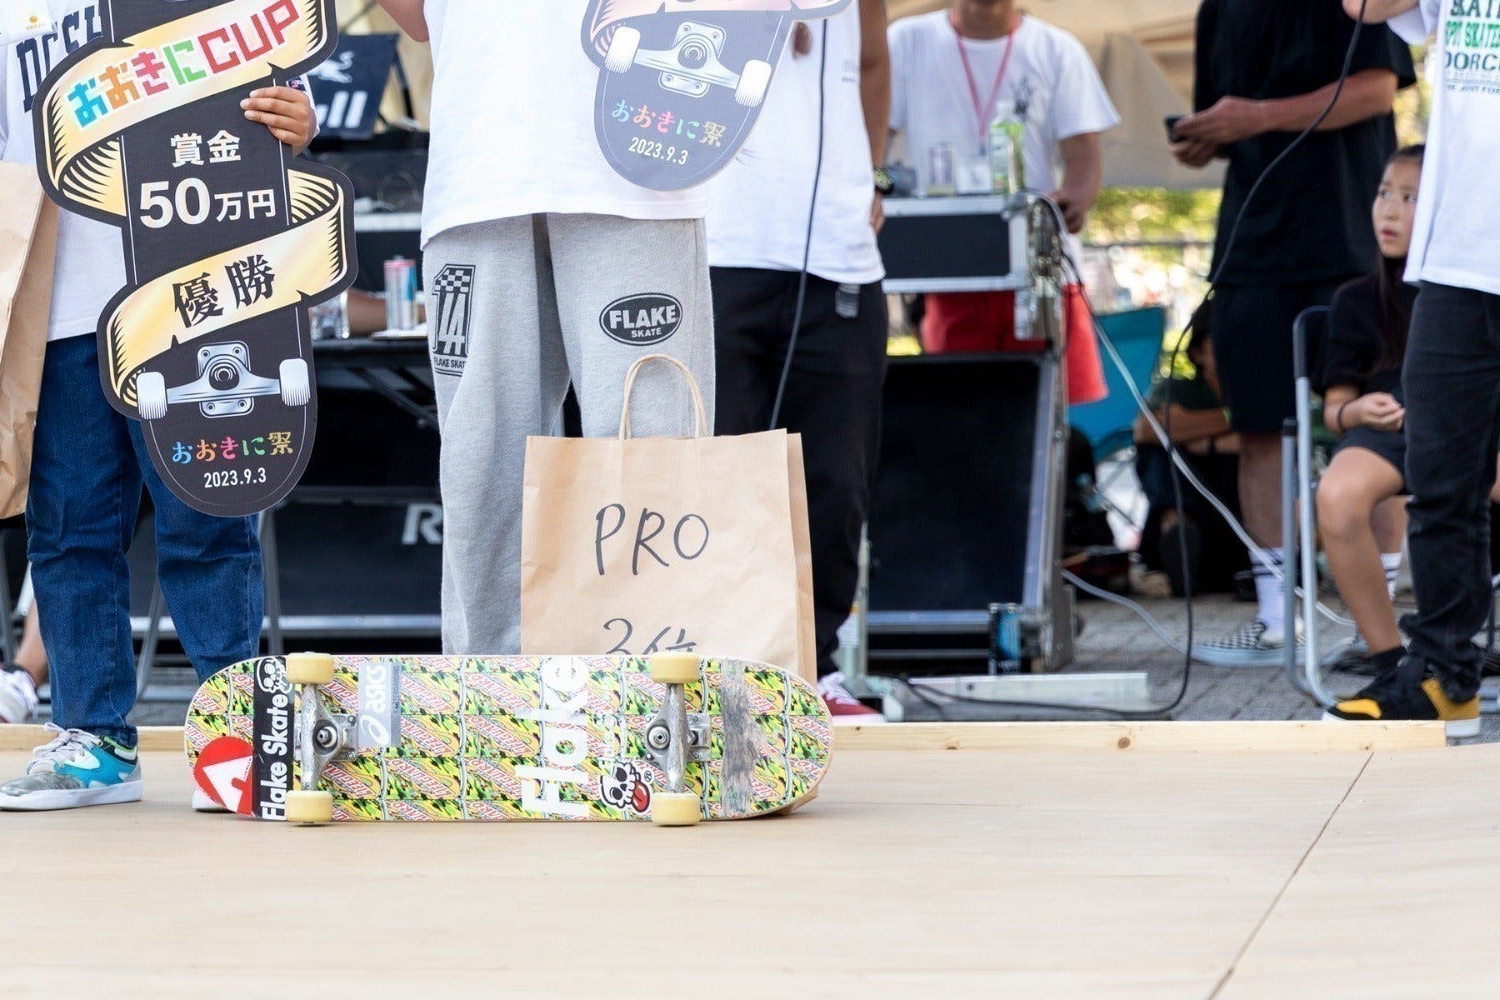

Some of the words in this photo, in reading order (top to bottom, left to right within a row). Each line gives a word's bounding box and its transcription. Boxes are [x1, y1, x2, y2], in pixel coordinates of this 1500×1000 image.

[611, 98, 727, 149] おおきに祭
[170, 130, 242, 168] 賞金
[628, 136, 688, 165] 2023.9.3
[139, 177, 277, 229] 50万円
[172, 254, 276, 329] 優勝
[609, 305, 676, 329] FLAKE
[631, 328, 662, 338] SKATE
[171, 431, 294, 464] おおきに祭
[204, 468, 267, 488] 2023.9.3
[594, 503, 709, 576] PRO
[365, 664, 387, 713] asics
[261, 693, 288, 756] Skate
[261, 761, 288, 820] Flake
